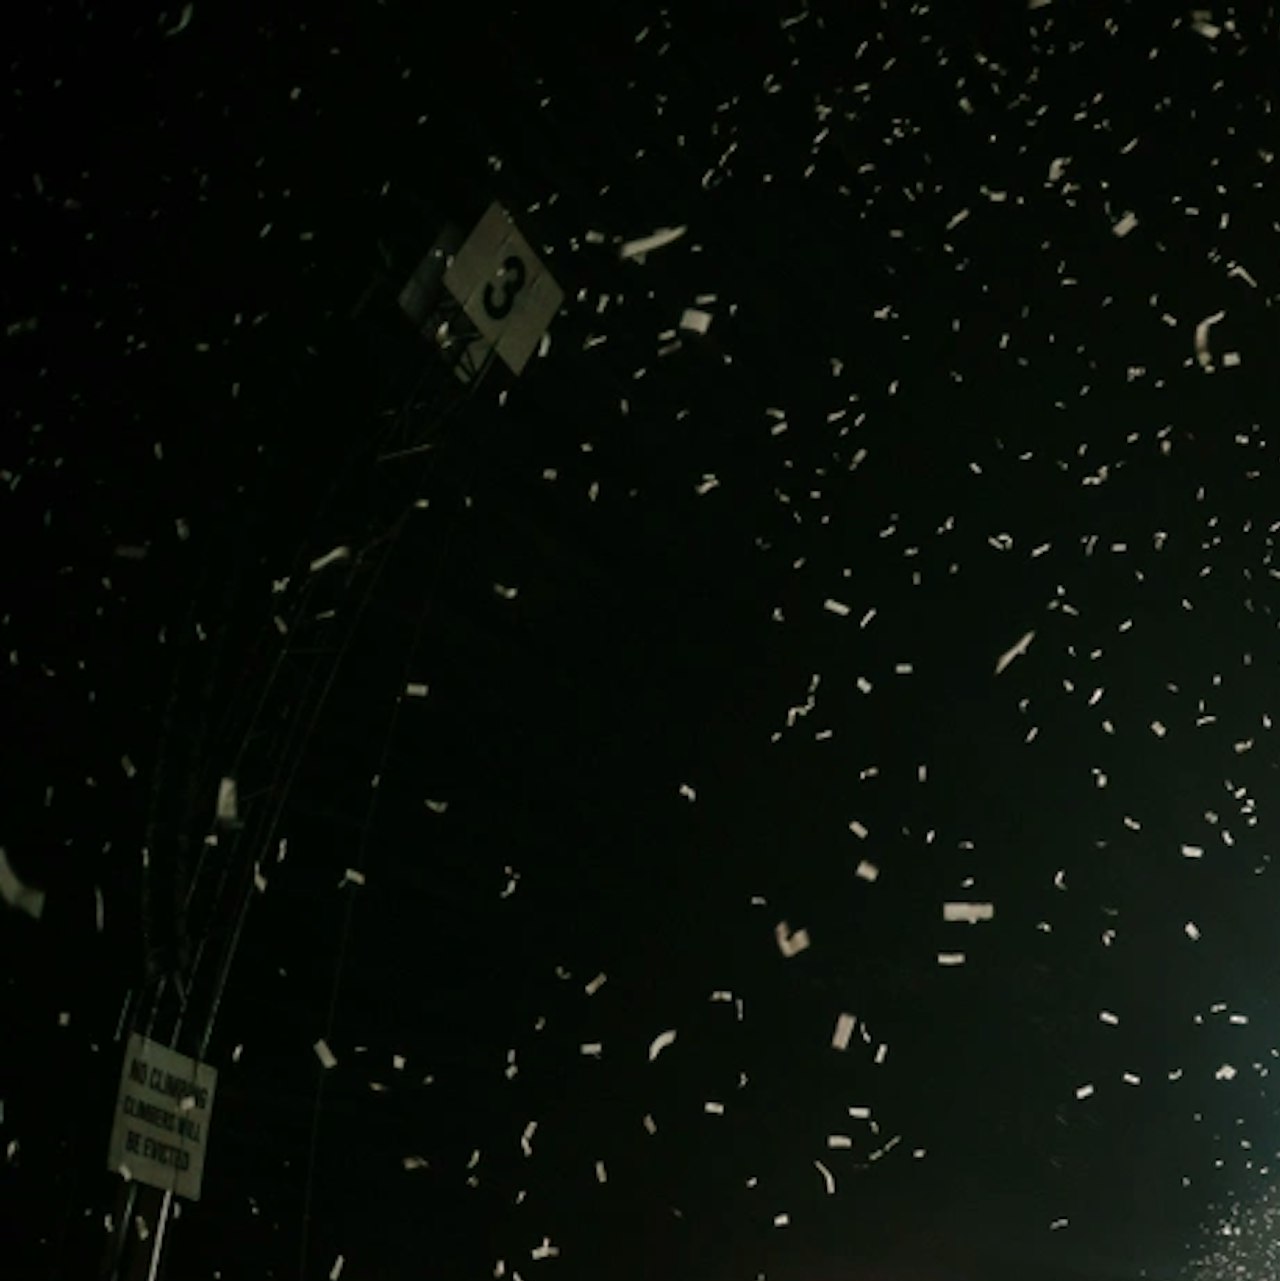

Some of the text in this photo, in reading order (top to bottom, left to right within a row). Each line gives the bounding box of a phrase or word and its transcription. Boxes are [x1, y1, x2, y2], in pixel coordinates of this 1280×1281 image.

[484, 256, 525, 320] 3
[130, 1058, 147, 1084] NO
[126, 1130, 142, 1154] BE
